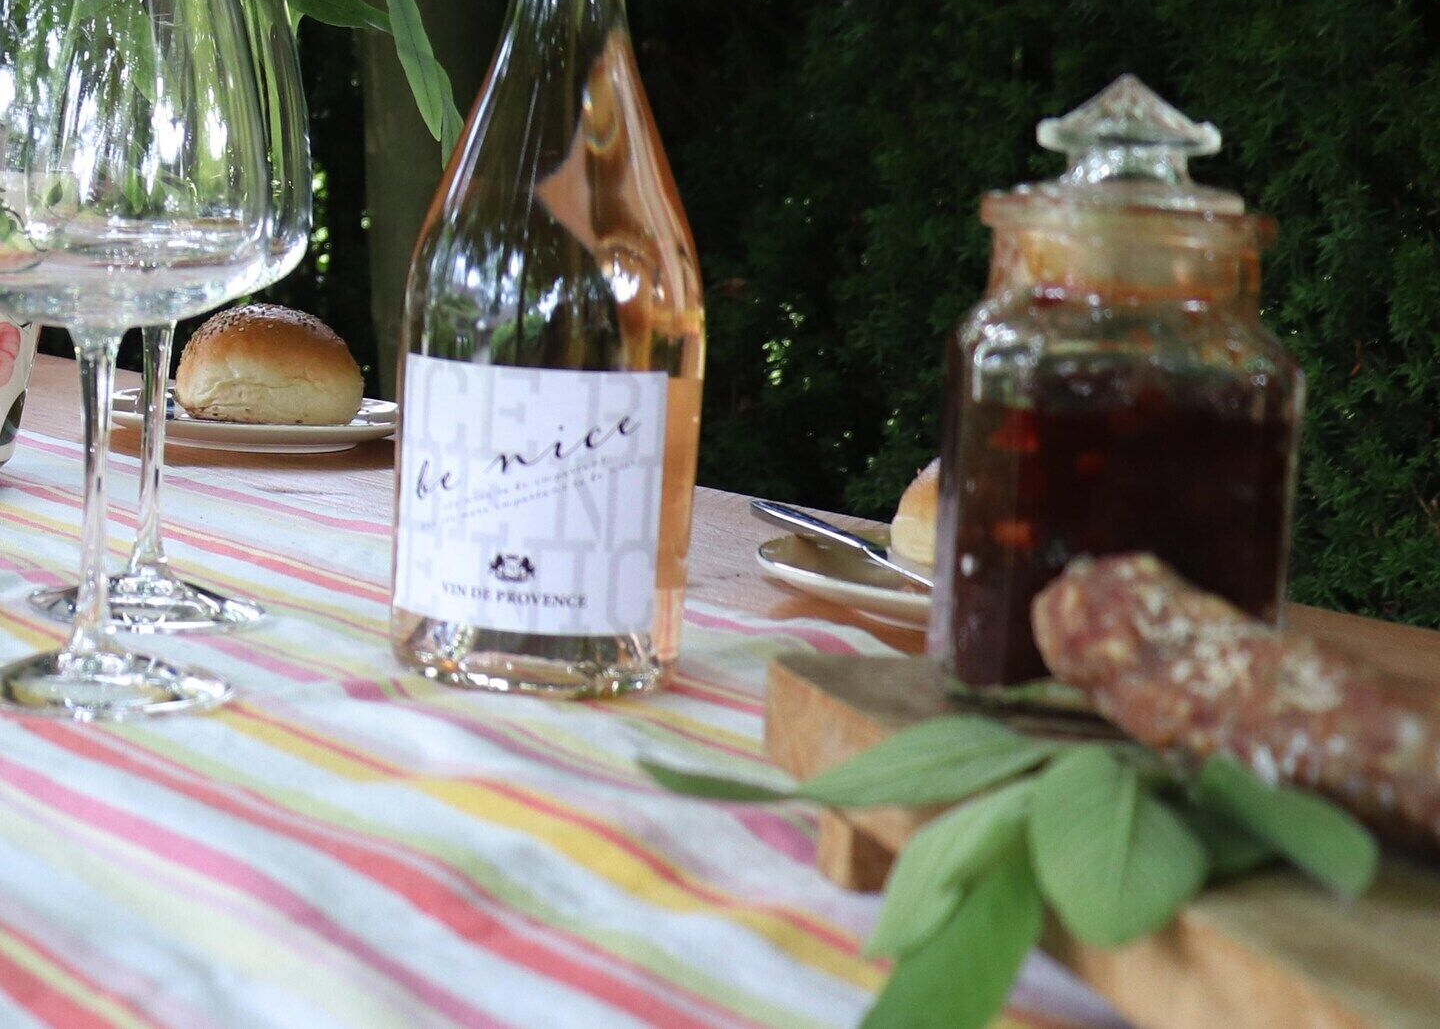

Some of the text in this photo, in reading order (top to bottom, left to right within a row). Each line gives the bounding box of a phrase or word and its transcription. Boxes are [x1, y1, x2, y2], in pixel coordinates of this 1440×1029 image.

[416, 458, 460, 501] be
[486, 414, 643, 476] nice
[441, 581, 589, 610] VIN DE PROVENCE
